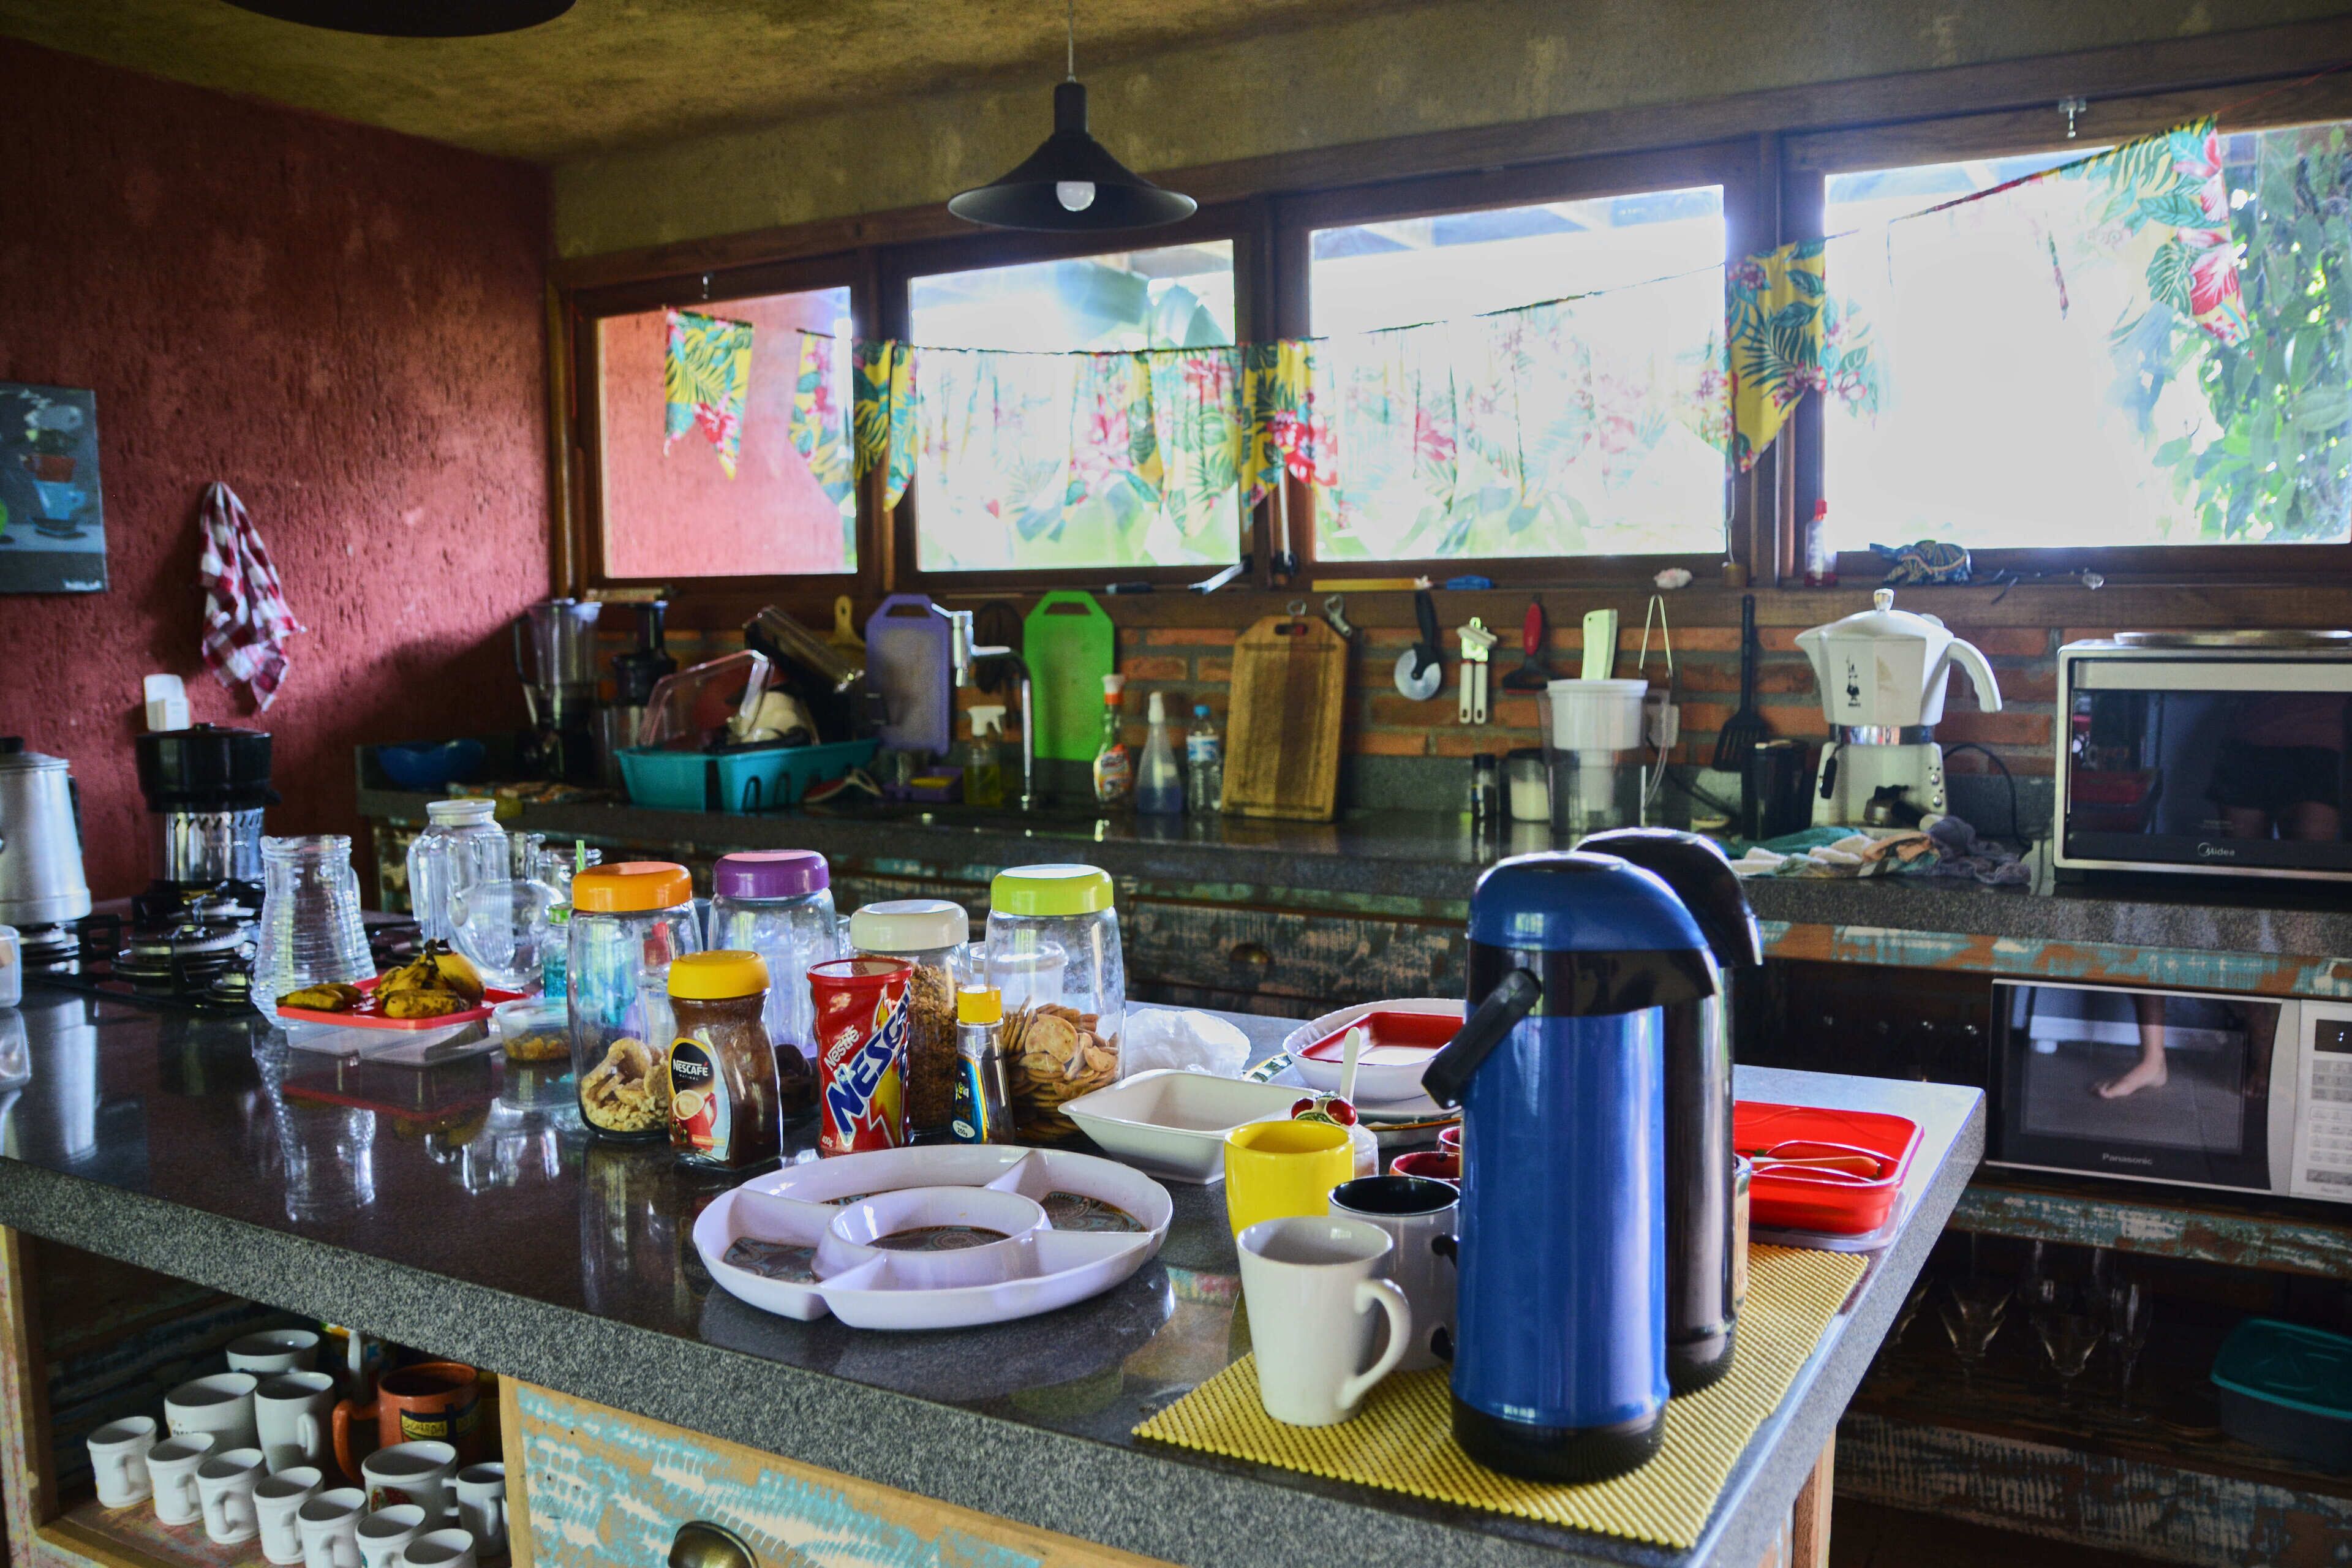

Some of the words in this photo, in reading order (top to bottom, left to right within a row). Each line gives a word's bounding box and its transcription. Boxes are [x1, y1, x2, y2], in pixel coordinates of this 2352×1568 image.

[2198, 843, 2235, 857] Midea
[824, 1024, 859, 1072] Nestlé
[673, 1058, 708, 1076] NESCAFÉ
